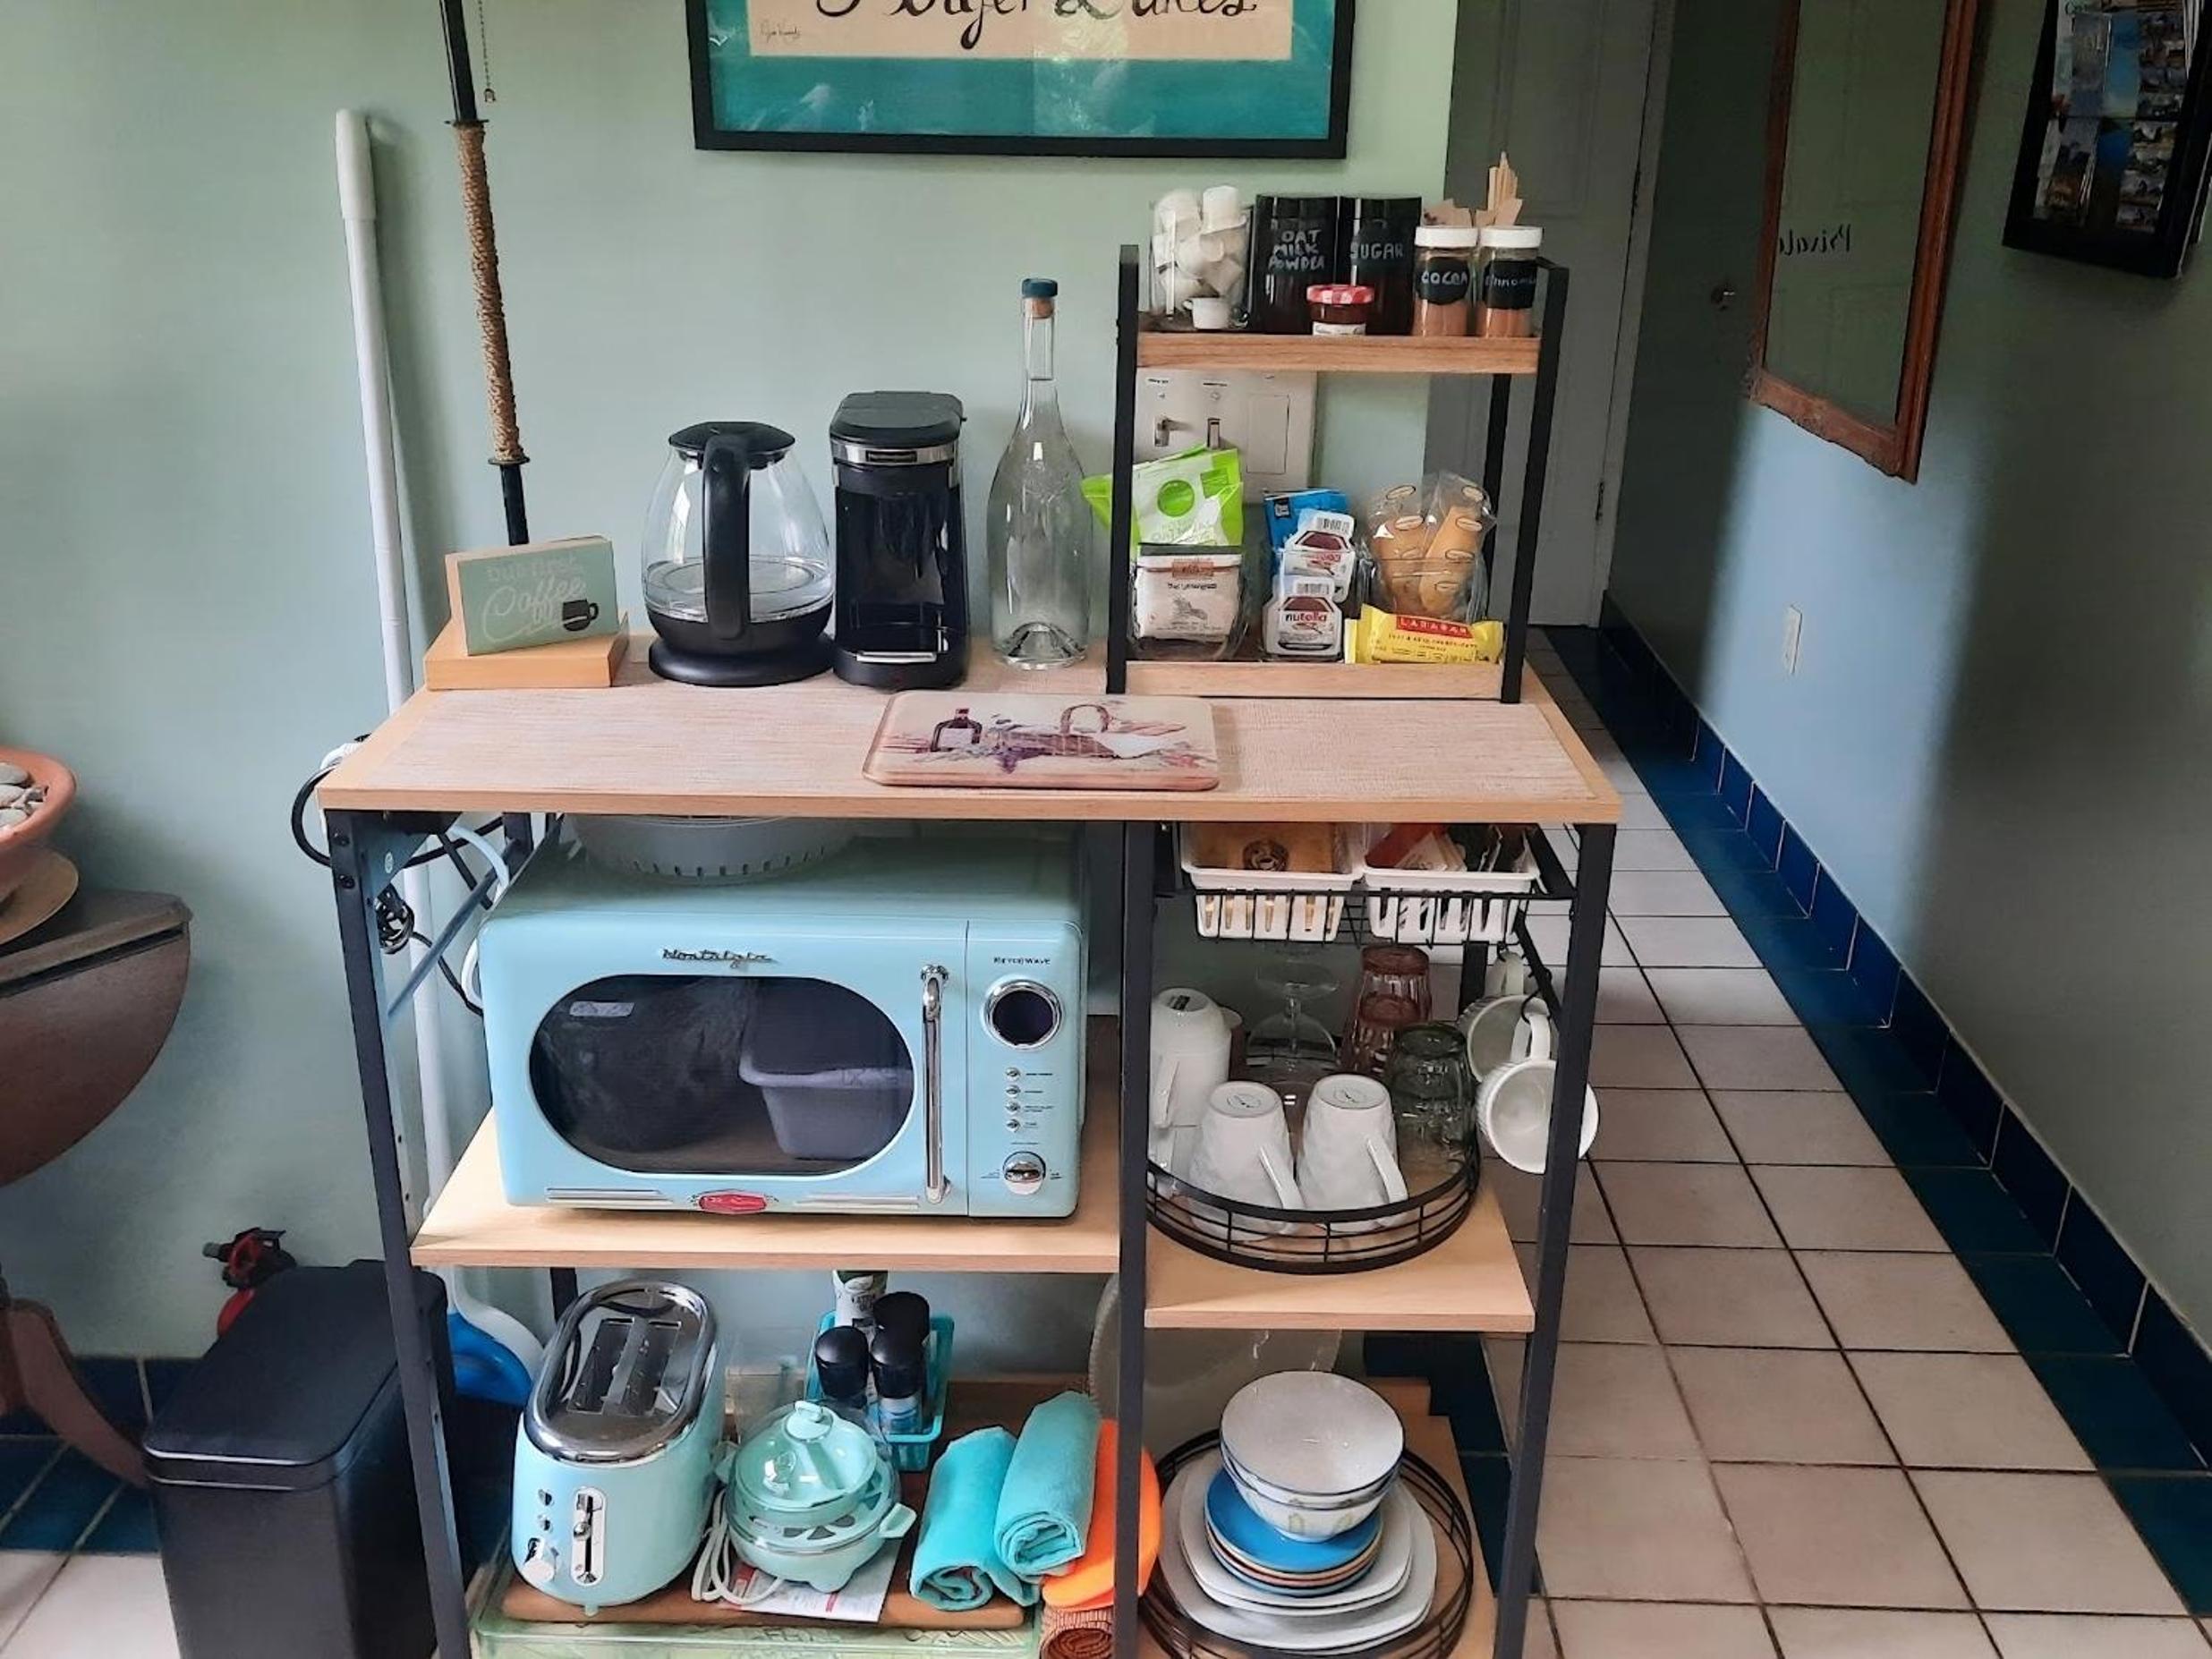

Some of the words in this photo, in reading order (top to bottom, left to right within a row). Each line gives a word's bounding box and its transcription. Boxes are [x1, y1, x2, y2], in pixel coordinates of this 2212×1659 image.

[1281, 229, 1322, 243] OAT
[1273, 242, 1319, 257] MILK
[1350, 242, 1404, 259] SUGAR
[482, 575, 589, 643] Coffee
[1285, 612, 1328, 623] nutella
